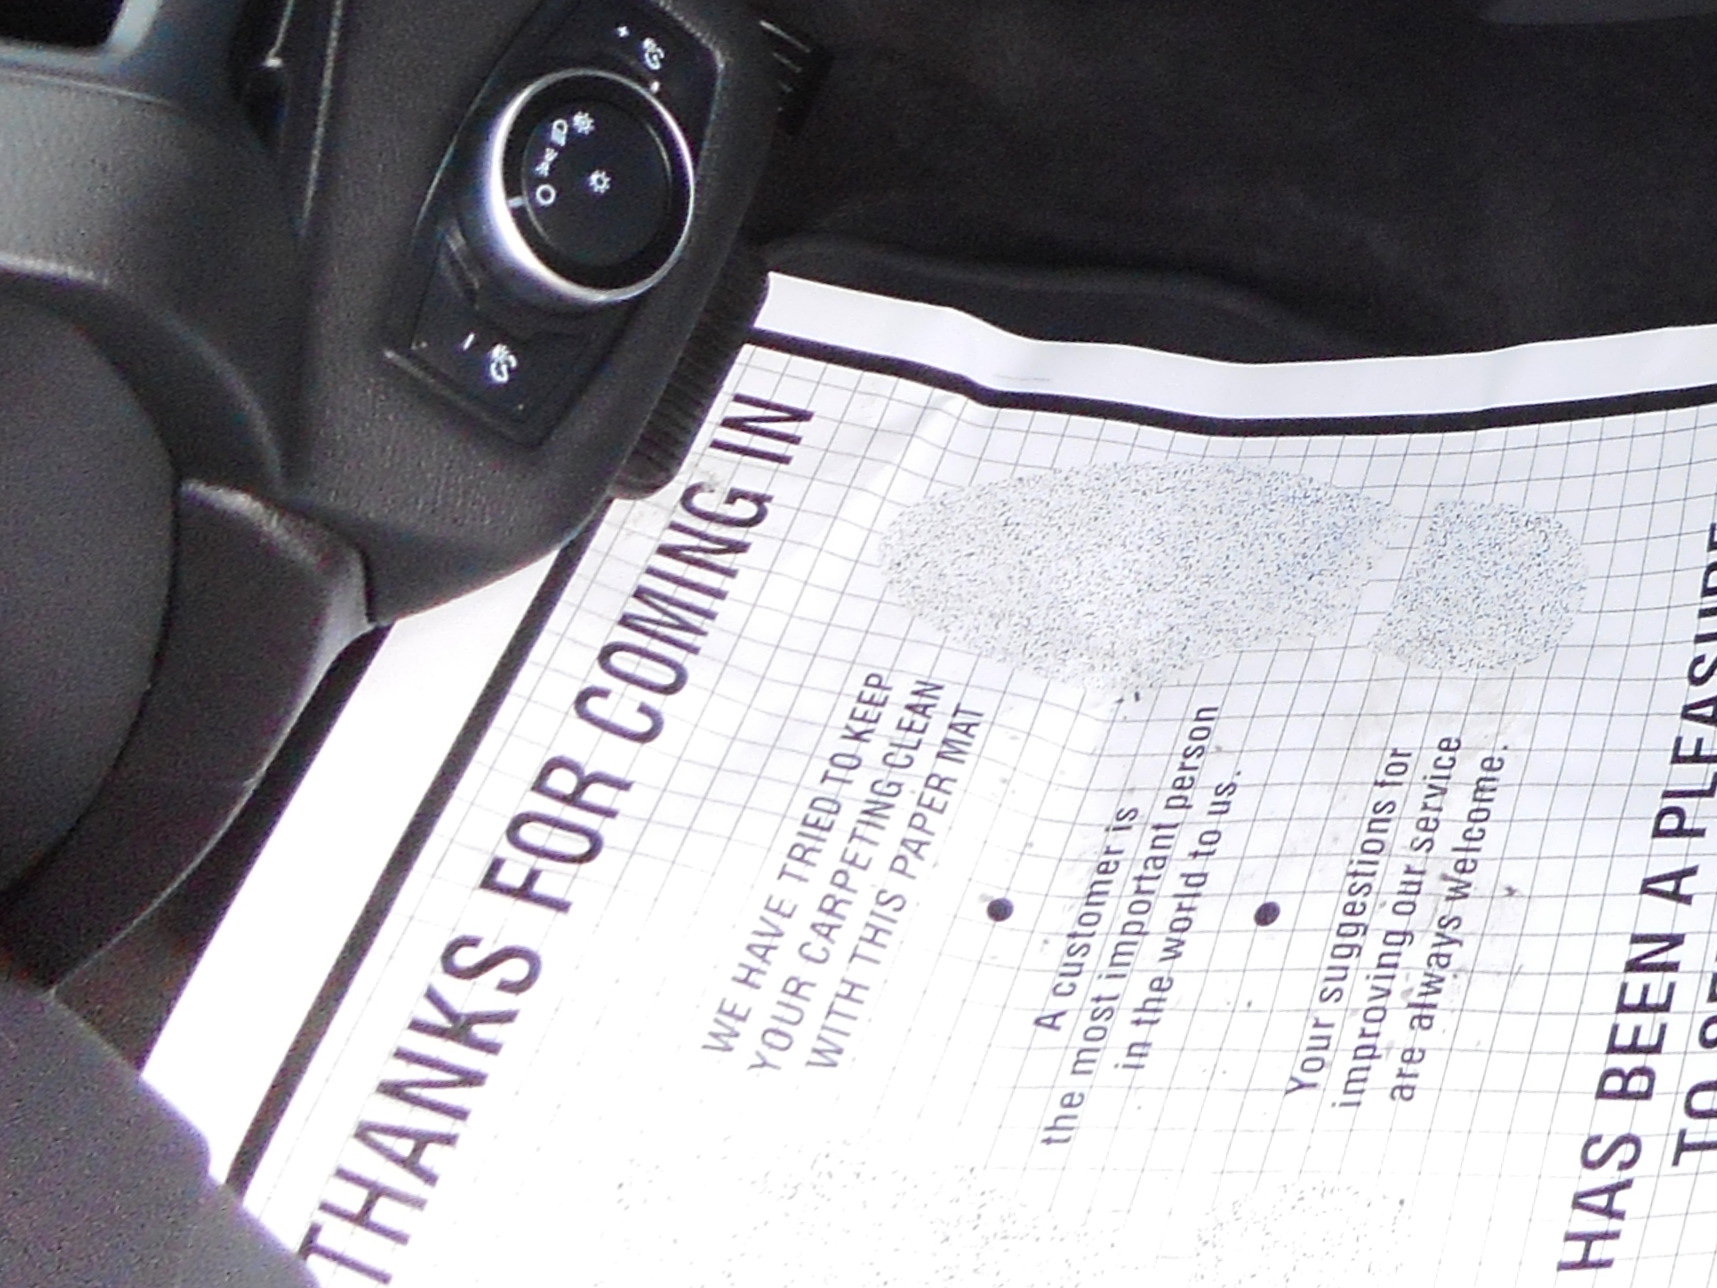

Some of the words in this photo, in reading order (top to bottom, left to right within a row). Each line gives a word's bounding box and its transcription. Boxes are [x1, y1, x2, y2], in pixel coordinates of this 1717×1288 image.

[840, 672, 894, 744] KEEP
[820, 752, 863, 785] TO
[1208, 770, 1242, 816] us.
[298, 933, 543, 1286] THANKS
[478, 754, 635, 914] FOR
[573, 481, 774, 745] COMING
[709, 393, 815, 465] IN
[777, 795, 842, 883] TRIED
[1187, 828, 1222, 861] to
[1446, 745, 1509, 903] welcome.
[746, 975, 817, 1072] YOUR
[797, 778, 904, 965] CARPETING
[881, 679, 945, 771] CLEAN
[805, 977, 870, 1069] WITH
[849, 888, 908, 965] THIS
[889, 772, 958, 881] PAPER
[935, 703, 985, 765] MAT
[1033, 1009, 1067, 1031] A
[1052, 844, 1125, 998] customer
[1104, 805, 1140, 833] is
[1159, 870, 1208, 963] world
[1284, 1016, 1336, 1097] Your
[1319, 799, 1398, 1003] suggestions
[1373, 749, 1413, 788] for
[1331, 929, 1415, 1109] improving
[1392, 862, 1427, 916] our
[1410, 735, 1462, 854] service
[1640, 865, 1699, 906] A
[731, 894, 799, 990] HAVE
[1041, 1090, 1085, 1146] the
[1070, 993, 1121, 1076] most
[1096, 821, 1180, 981] important
[1164, 705, 1219, 810] person
[1407, 914, 1464, 1032] always
[701, 997, 752, 1054] WE
[1131, 974, 1174, 1027] the
[1594, 932, 1686, 1101] BEEN
[1113, 1040, 1152, 1071] in
[1389, 1046, 1427, 1103] are
[1556, 1131, 1643, 1272] HAS
